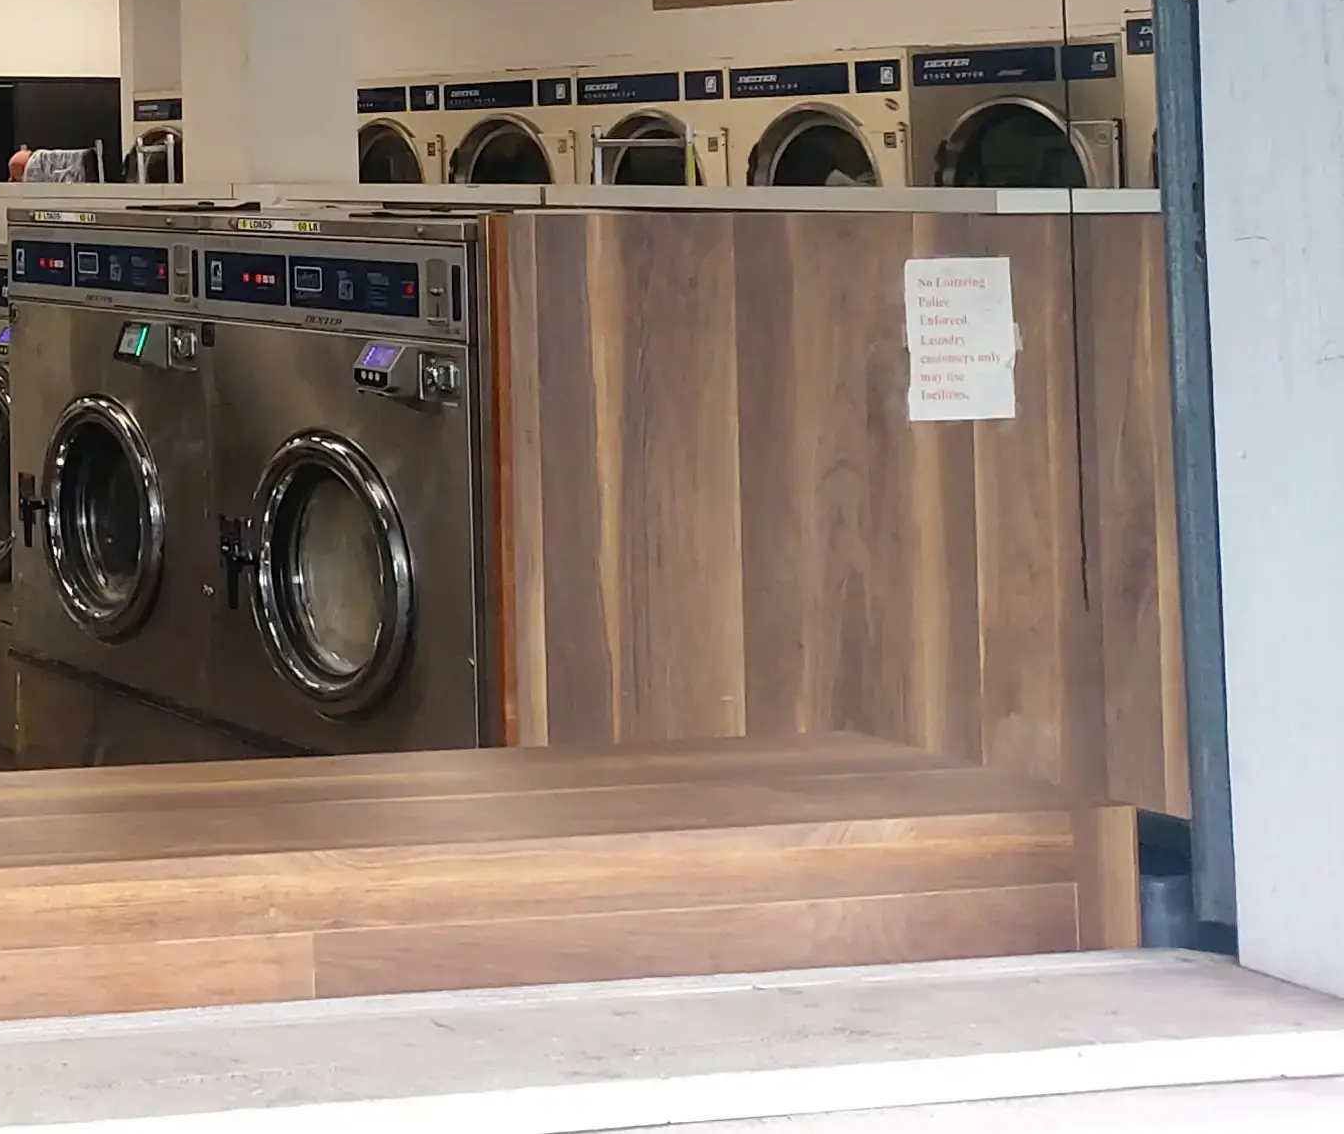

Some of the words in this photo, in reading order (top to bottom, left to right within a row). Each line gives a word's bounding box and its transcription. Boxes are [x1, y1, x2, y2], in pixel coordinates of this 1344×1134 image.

[923, 57, 971, 68] DEXTER
[737, 74, 778, 84] DEXTER
[584, 82, 619, 92] DEXTER
[249, 219, 272, 229] LOADS
[918, 277, 933, 287] No
[918, 296, 950, 307] Police
[304, 314, 343, 326] DEXTER
[920, 333, 965, 347] Laundry
[977, 350, 1001, 364] only
[920, 373, 941, 384] may
[947, 373, 965, 383] use
